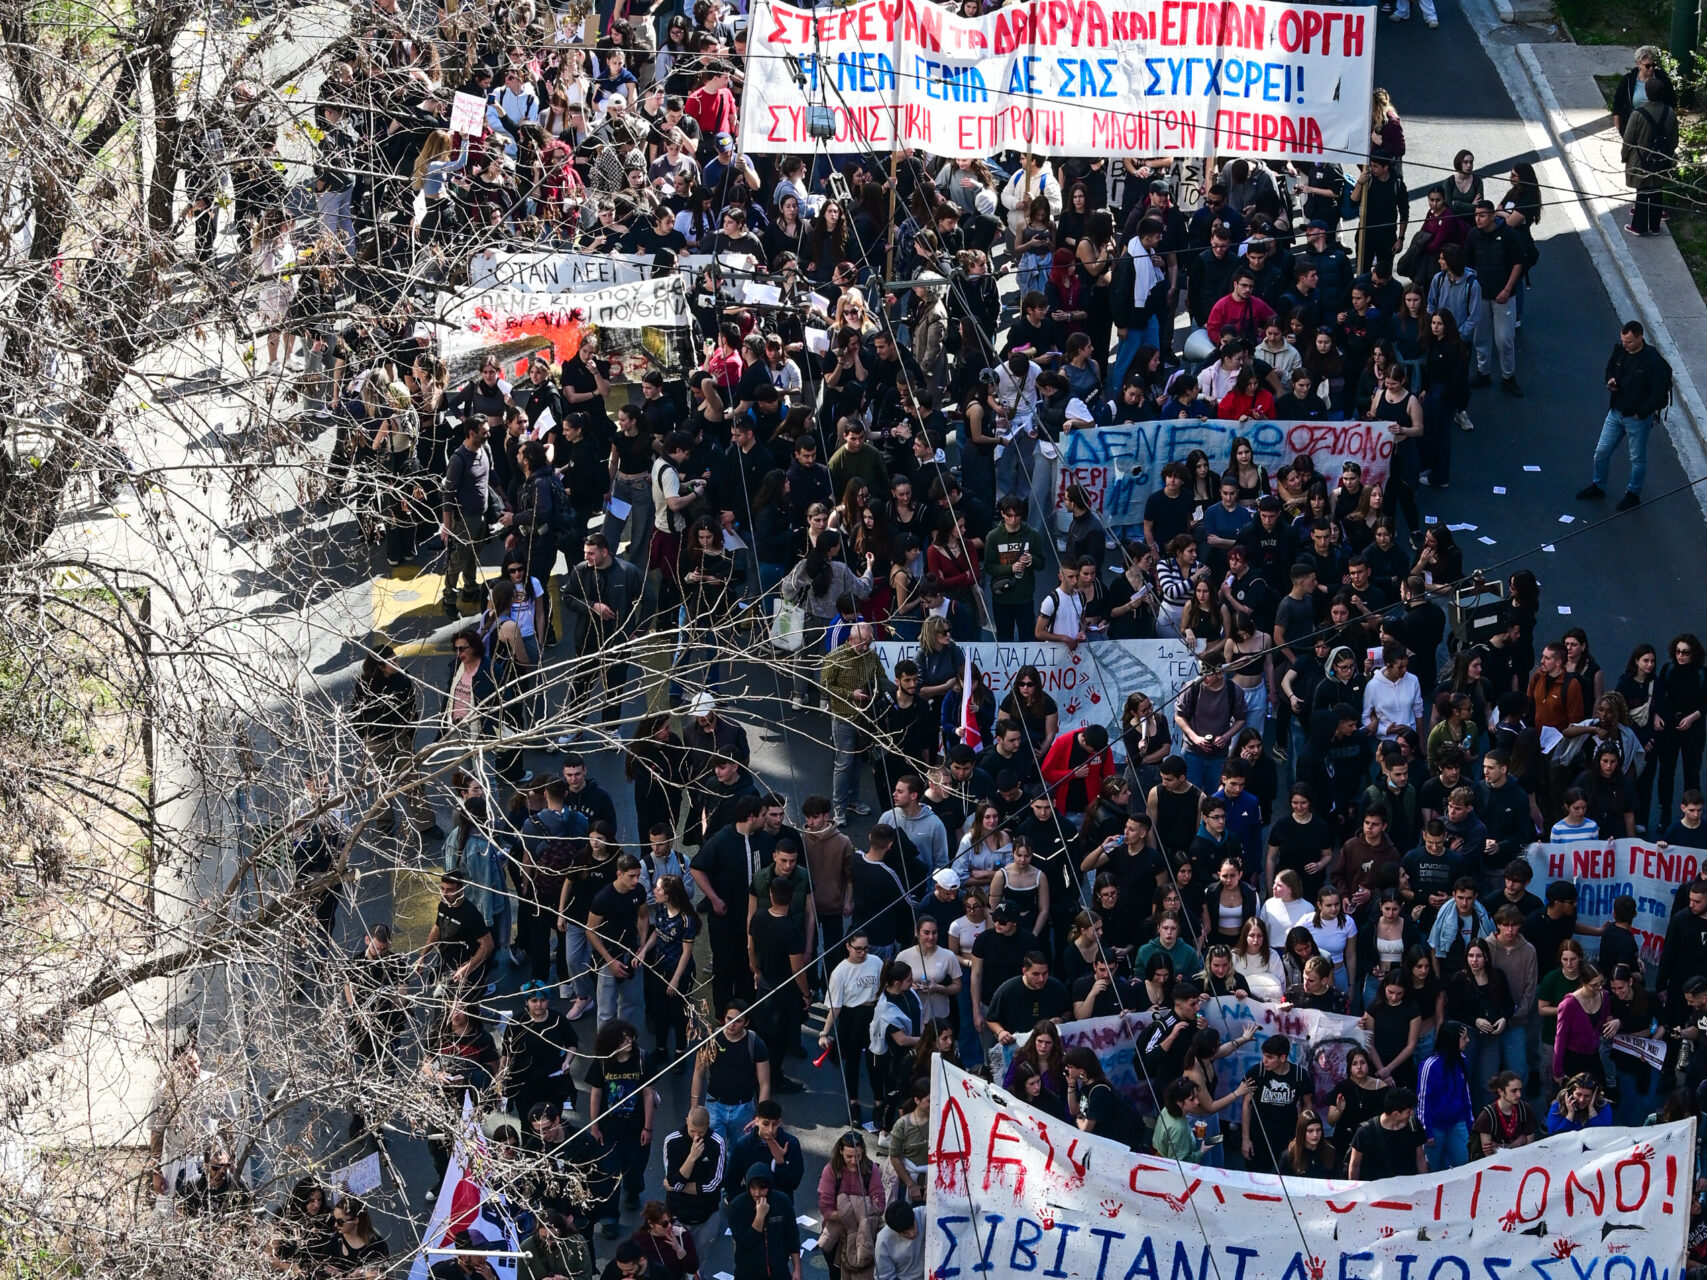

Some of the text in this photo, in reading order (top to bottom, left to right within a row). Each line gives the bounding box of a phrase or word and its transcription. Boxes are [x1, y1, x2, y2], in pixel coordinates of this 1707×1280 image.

[1112, 10, 1157, 41] ΚΑΙ
[1160, 0, 1266, 51] ΕΓΙΝΑΝ
[1278, 9, 1365, 57] ΟΡΓΗ
[837, 51, 896, 93] ΝΕΑ
[915, 54, 989, 104] ΓΕΝΙΑ
[1009, 56, 1043, 96] ΔΕ
[1057, 58, 1118, 98] ΣΑΣ
[767, 103, 1324, 155] ΣΥΟΝΙΣΤΙΚΗ ΕΠΙΤΡΟΠΗ ΜΑΘΗΤΩΝ ΠΕΙΡΑΙΑ
[495, 260, 559, 286] ΟΤΑΝ
[572, 261, 618, 285] ΛΕΕΙ
[1068, 425, 1162, 466] ΔΕΝ
[995, 646, 1058, 668] ΠΑΙΔΙ
[1169, 660, 1200, 677] ΓΕΛ
[1548, 845, 1698, 884] Η ΝΕΑ ΓΕΝΙΑ
[1260, 1085, 1297, 1105] LONSDALE
